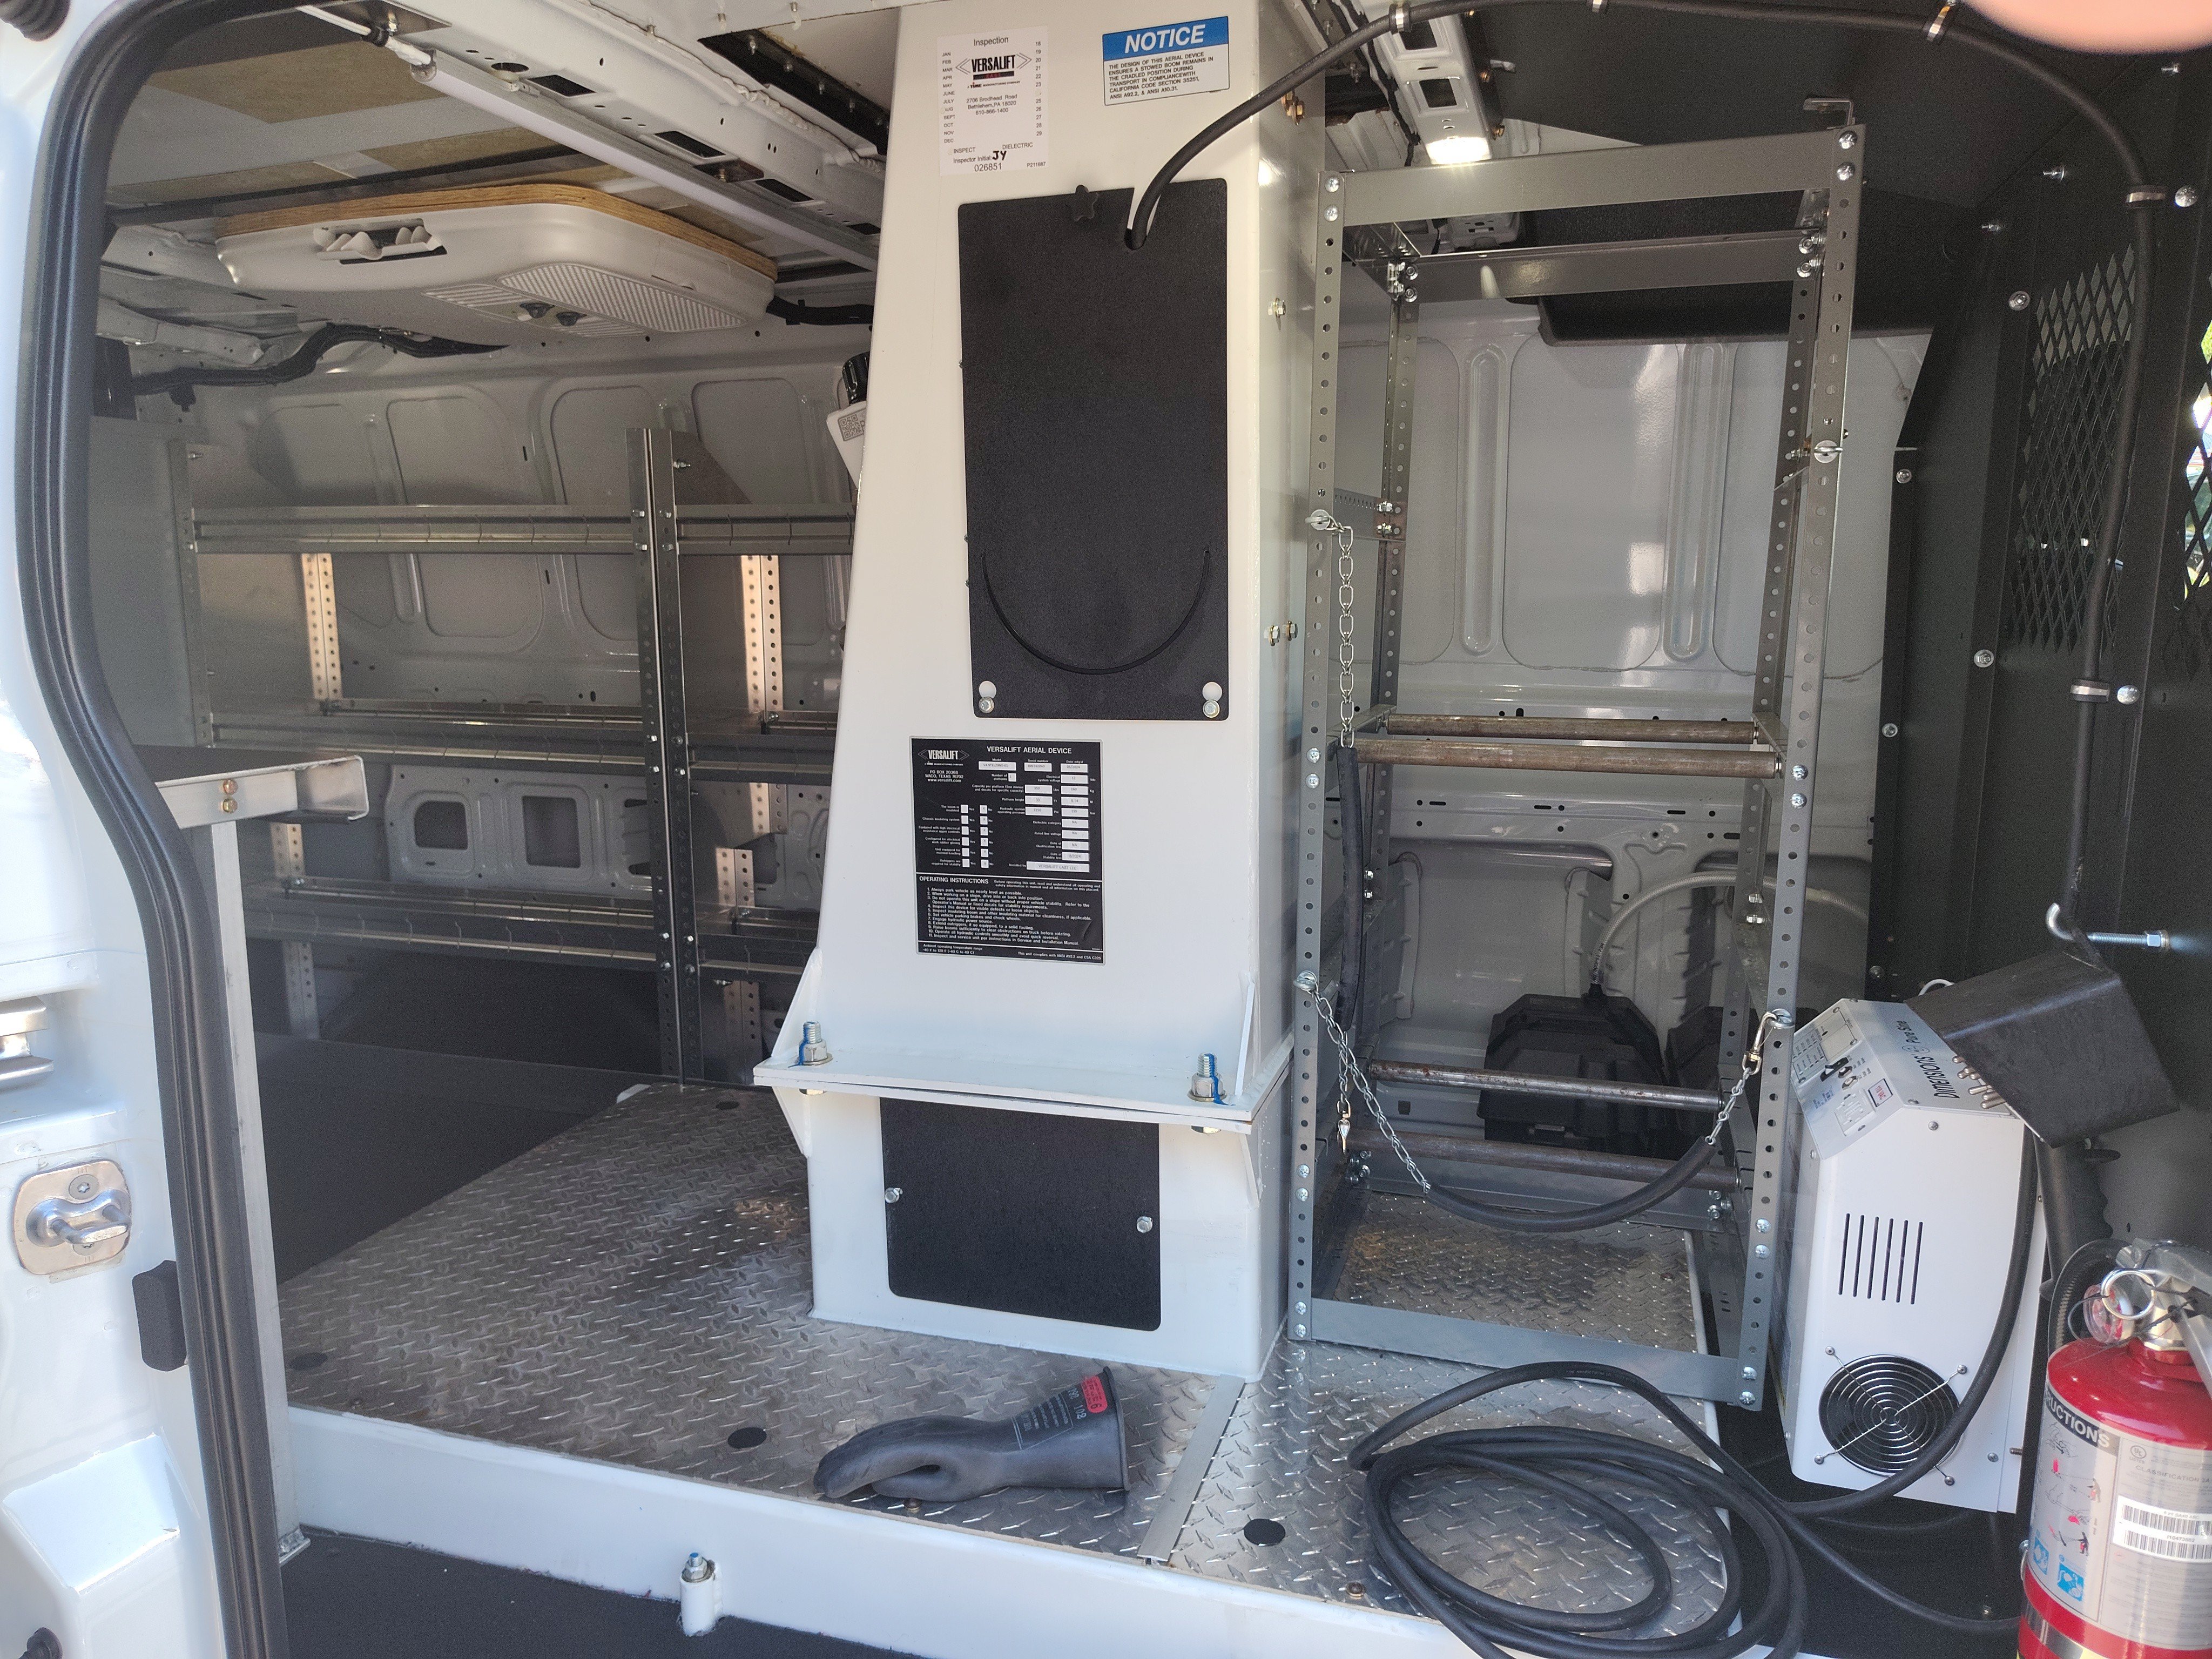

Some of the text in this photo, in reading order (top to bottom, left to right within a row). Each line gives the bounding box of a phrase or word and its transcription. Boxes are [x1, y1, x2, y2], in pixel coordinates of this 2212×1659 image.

[974, 37, 1009, 47] Inspection
[1125, 24, 1205, 53] NOTICE
[972, 55, 1015, 72] VERSALIFT
[1109, 79, 1139, 87] TRANSPORT
[1109, 85, 1139, 93] CALIFORNIA
[974, 163, 1002, 172] 026851
[928, 750, 959, 760] VERSALIFT
[1914, 1056, 1960, 1098] DIMENSIONS
[2136, 1465, 2199, 1482] CLASSIFICATION
